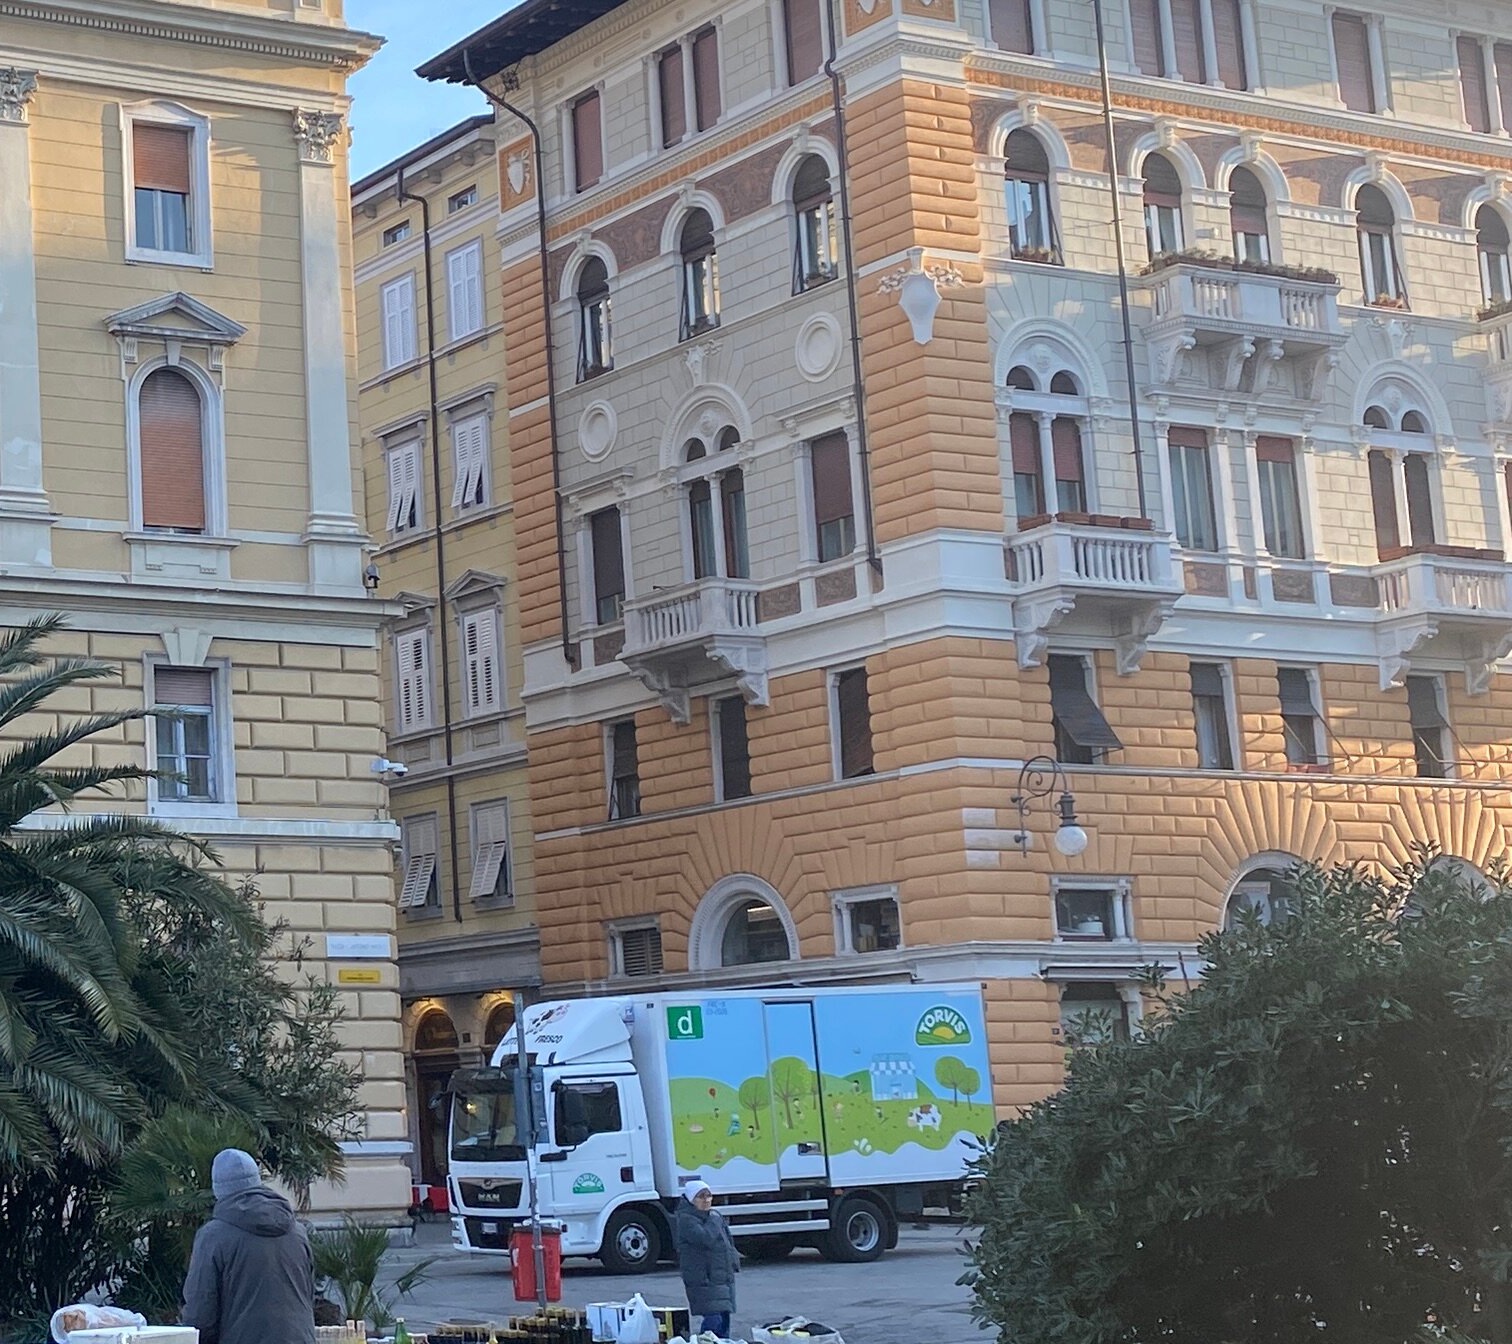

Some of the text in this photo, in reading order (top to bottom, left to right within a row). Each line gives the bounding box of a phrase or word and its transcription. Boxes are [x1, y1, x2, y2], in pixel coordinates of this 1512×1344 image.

[677, 1010, 693, 1035] d
[918, 1008, 966, 1034] TORVIS
[534, 1035, 563, 1044] FRESCO
[574, 1173, 603, 1188] TORVIS
